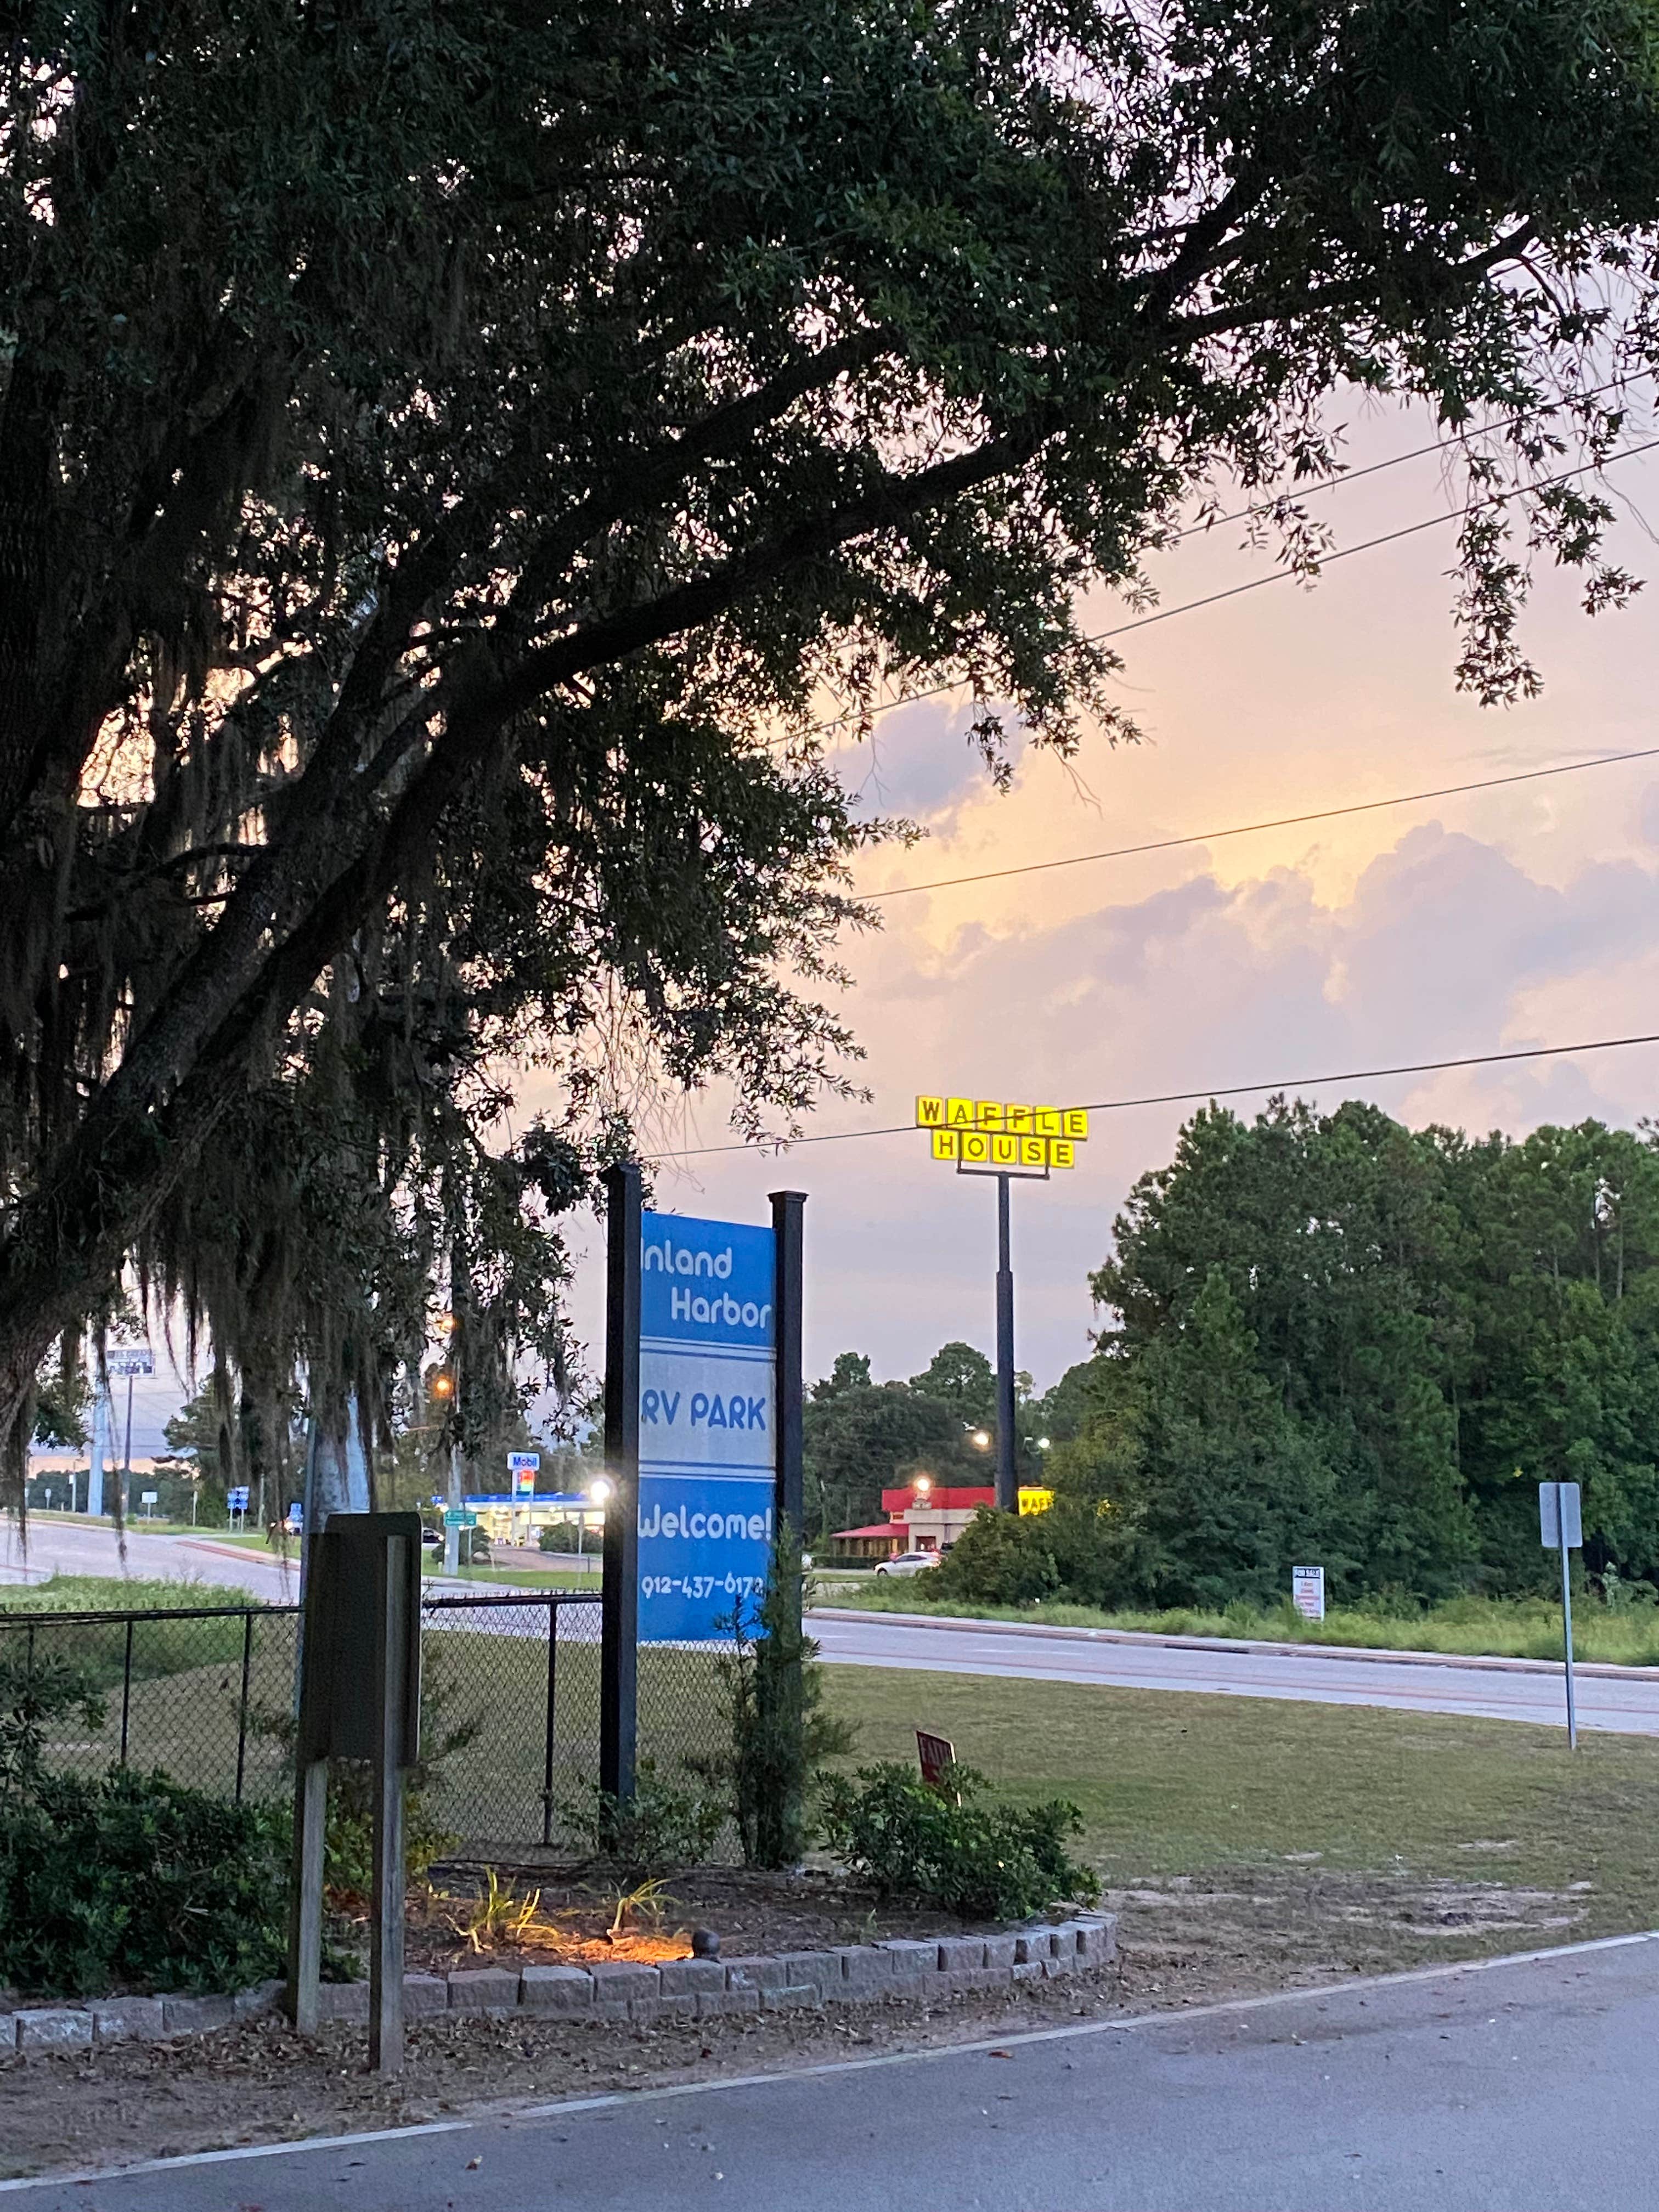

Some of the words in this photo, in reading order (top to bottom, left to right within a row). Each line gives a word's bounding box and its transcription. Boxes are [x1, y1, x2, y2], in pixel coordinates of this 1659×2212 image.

[922, 1101, 1084, 1133] WAFFLE
[939, 1135, 1070, 1164] HOUSE
[672, 1286, 771, 1329] Harbor
[641, 1389, 680, 1425] RV
[691, 1392, 766, 1431] PARK
[513, 1457, 537, 1466] Mobil
[638, 1503, 772, 1541] Welcome!
